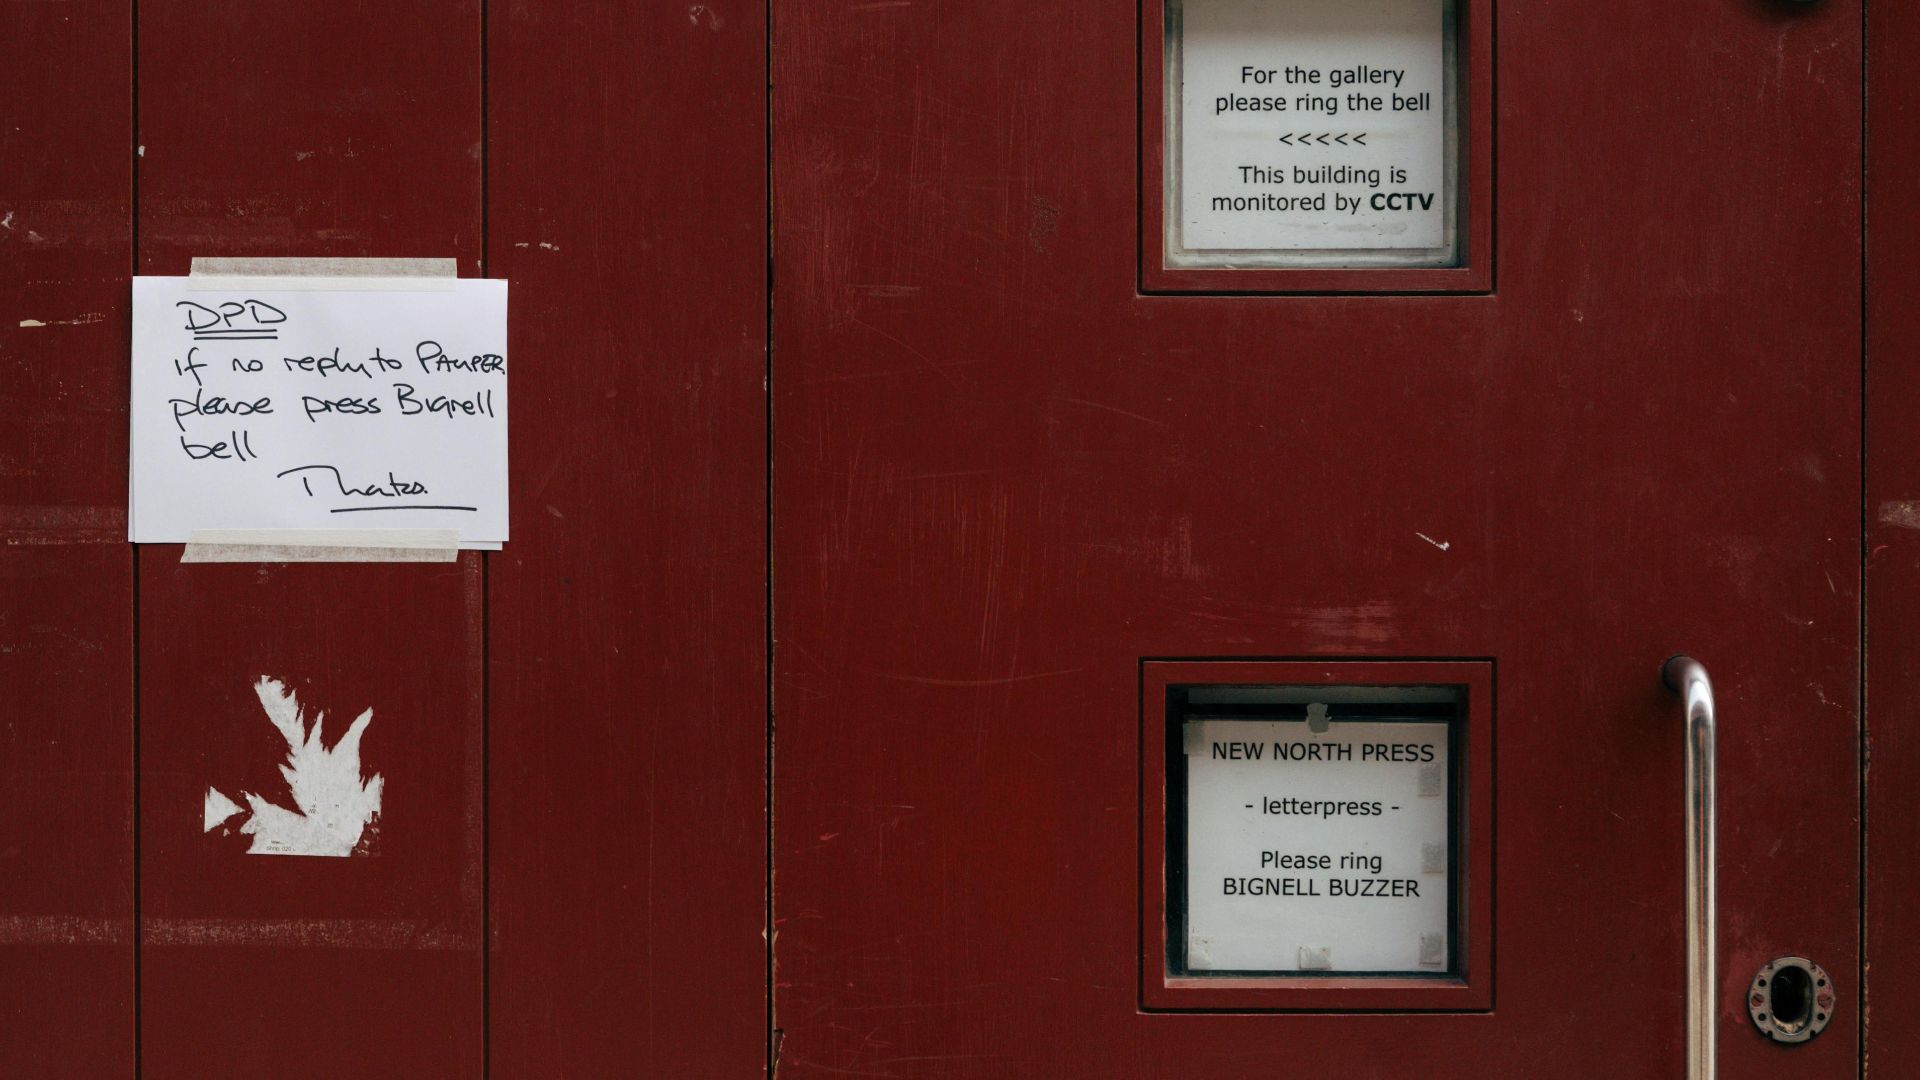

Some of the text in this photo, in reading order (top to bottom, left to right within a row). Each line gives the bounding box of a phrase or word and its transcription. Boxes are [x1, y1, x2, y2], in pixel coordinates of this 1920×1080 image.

[1242, 65, 1404, 88] For the gallery
[1216, 92, 1429, 115] please ring the bell
[1238, 165, 1406, 188] This building is
[1213, 193, 1434, 215] monitored by CCTV
[176, 299, 287, 329] DPD
[232, 358, 263, 372] no
[284, 347, 372, 378] reply
[369, 348, 402, 372] to
[168, 388, 273, 433] please
[302, 396, 381, 422] press
[180, 429, 257, 462] bell
[1213, 742, 1434, 762] NEW NORTH PRESS
[1264, 796, 1382, 819] letterpress
[1262, 851, 1381, 874] Please ring
[1224, 878, 1420, 897] BIGNELL BUZZER
